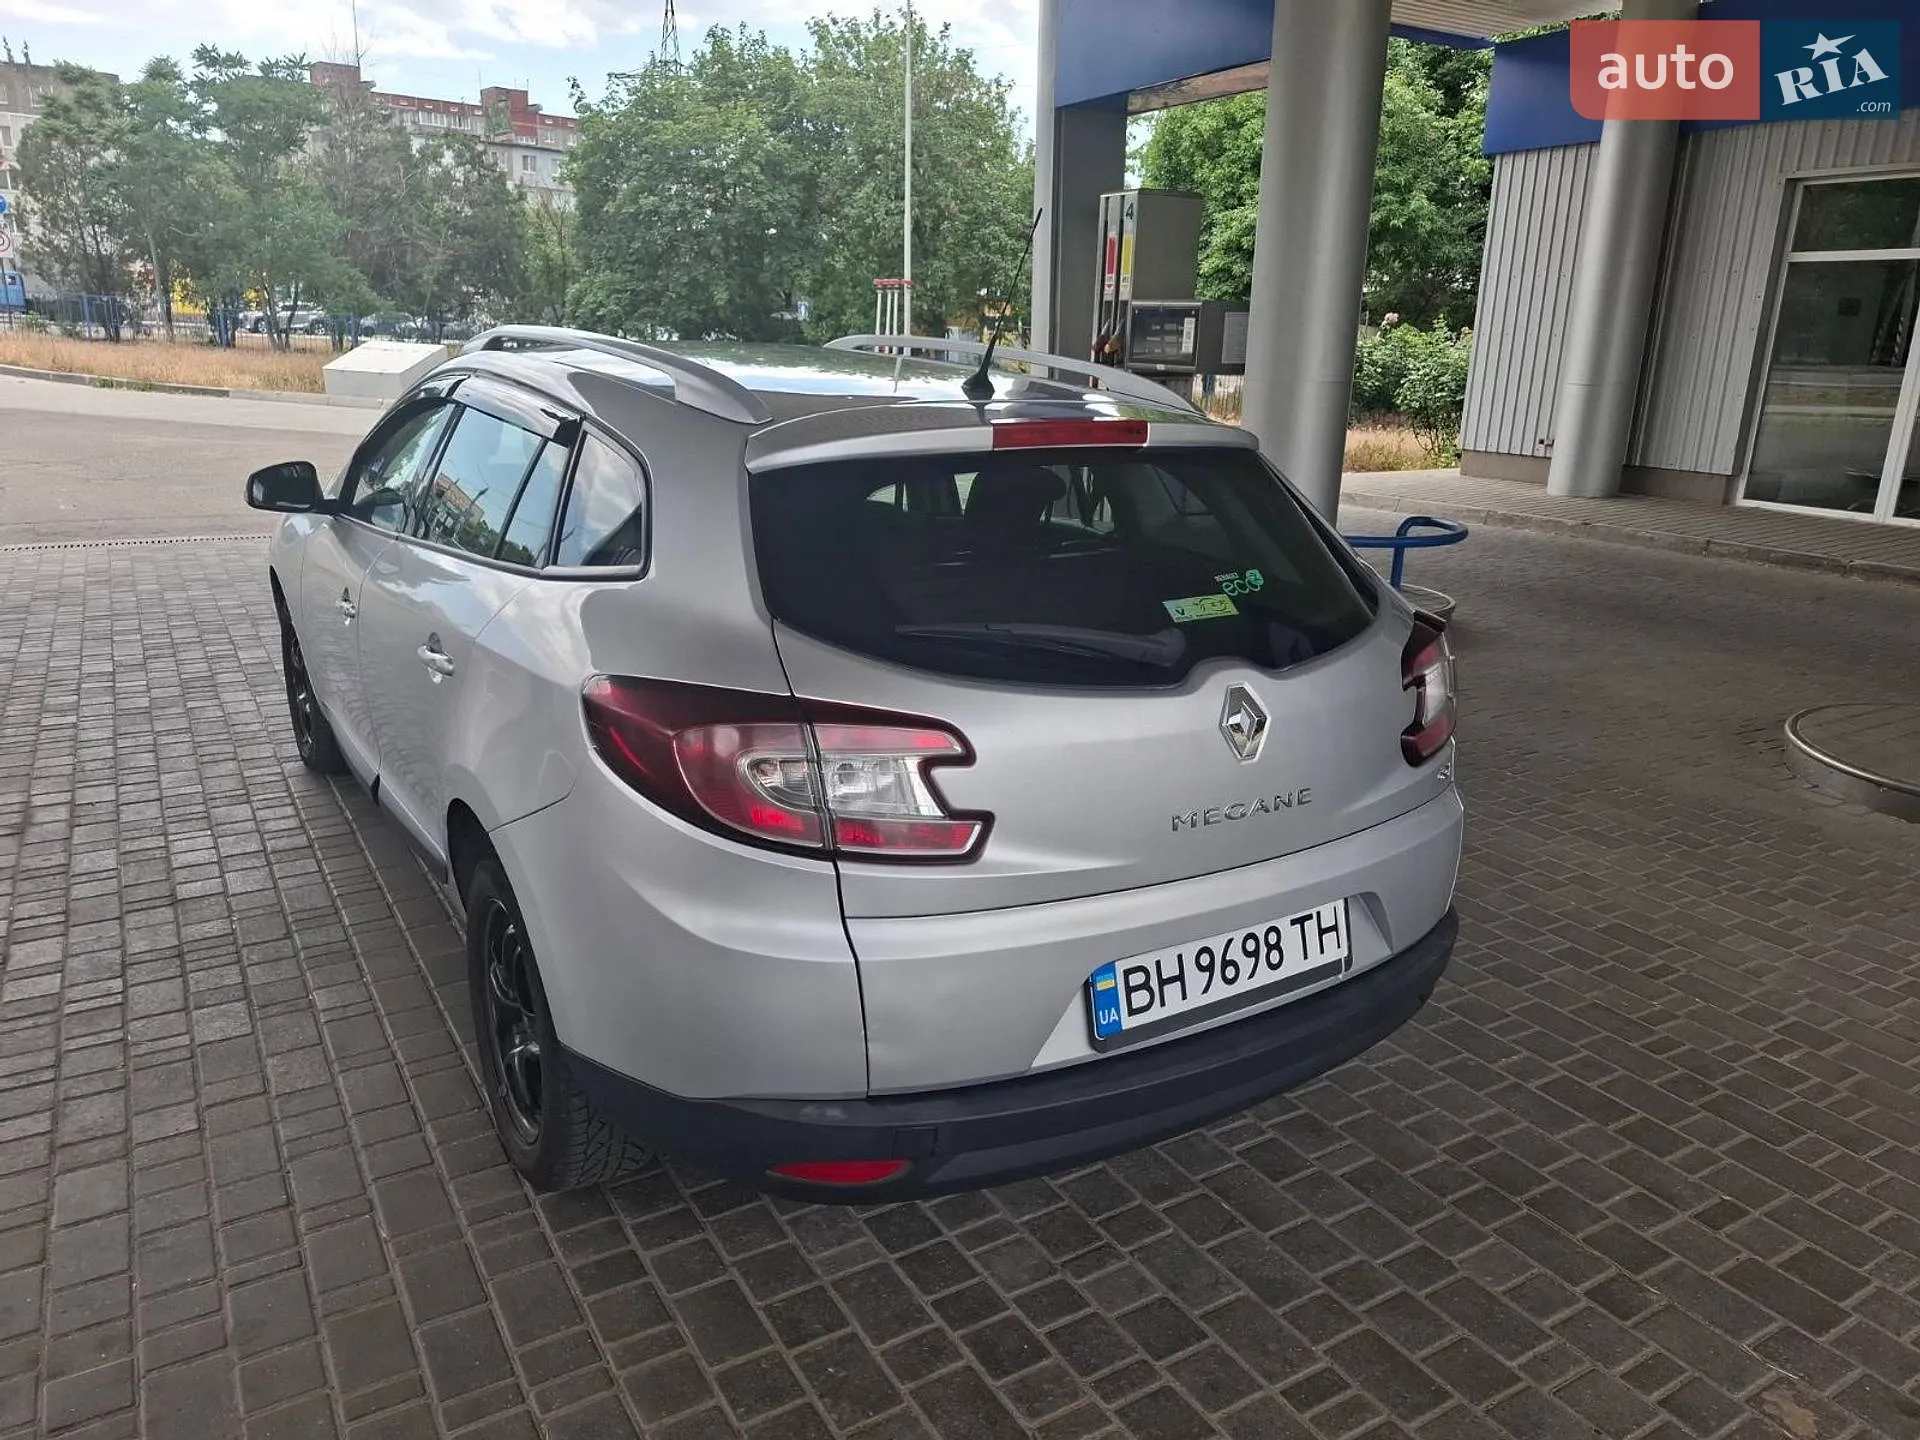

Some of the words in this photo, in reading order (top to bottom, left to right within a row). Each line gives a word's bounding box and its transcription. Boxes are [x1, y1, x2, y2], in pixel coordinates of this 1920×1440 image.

[1126, 202, 1134, 220] 4
[1171, 787, 1312, 832] MEGANE
[1122, 953, 1188, 1018] BH
[1194, 925, 1284, 995] 9698
[1290, 906, 1341, 960] TH
[1100, 1008, 1119, 1025] UA
